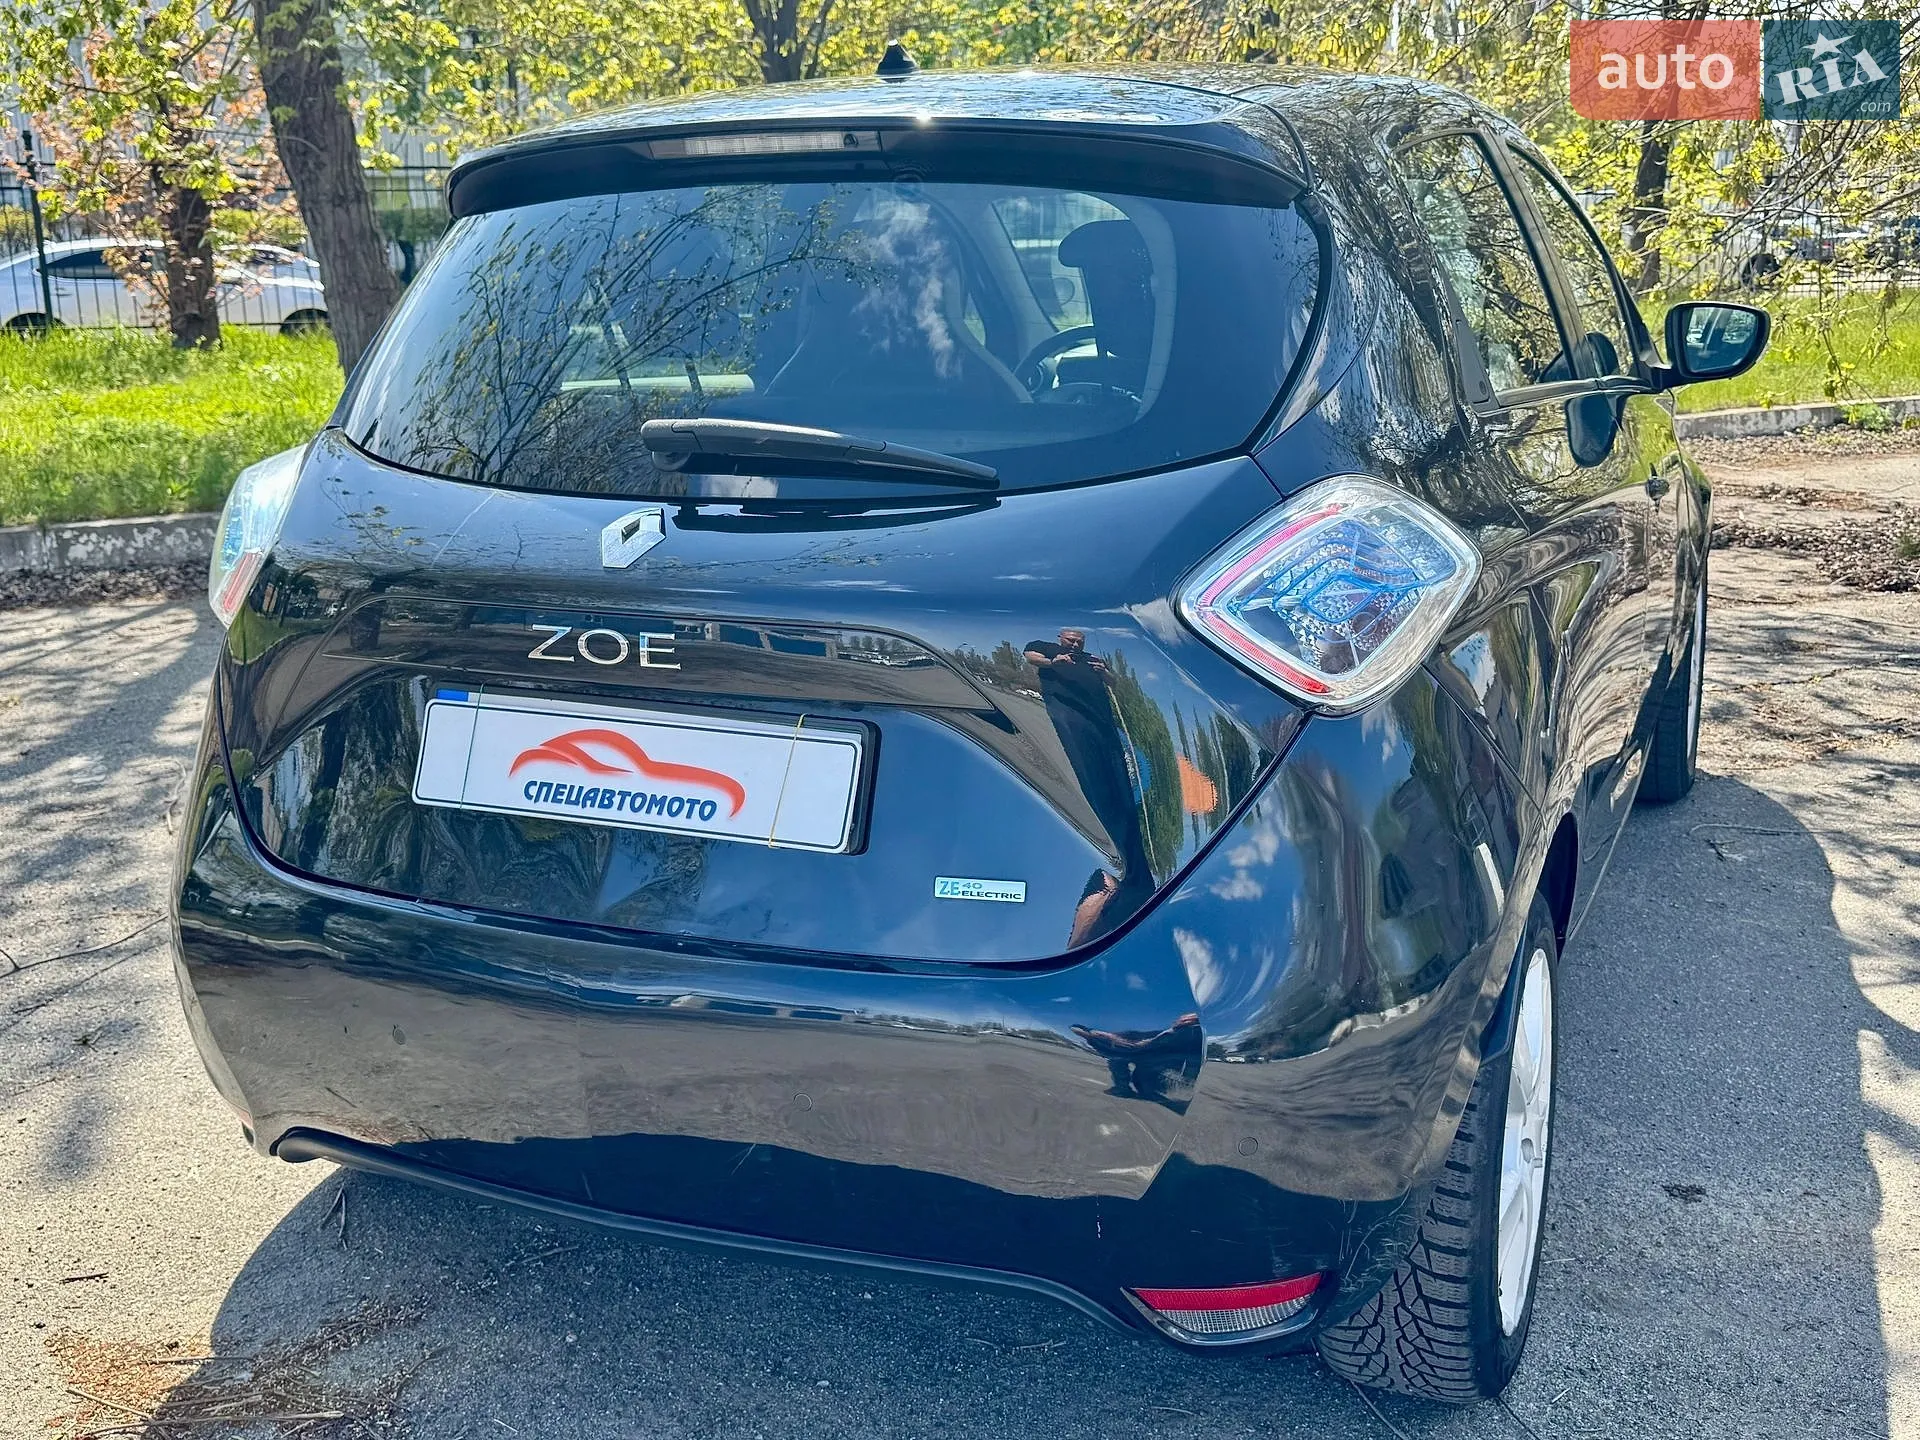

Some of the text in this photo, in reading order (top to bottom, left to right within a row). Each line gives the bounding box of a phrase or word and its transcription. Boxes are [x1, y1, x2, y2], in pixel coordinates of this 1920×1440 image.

[527, 624, 682, 670] ZOE
[523, 780, 718, 822] СПЕЦАВТОМОТО
[962, 882, 983, 890] 40
[962, 890, 1022, 899] ELECTRIC
